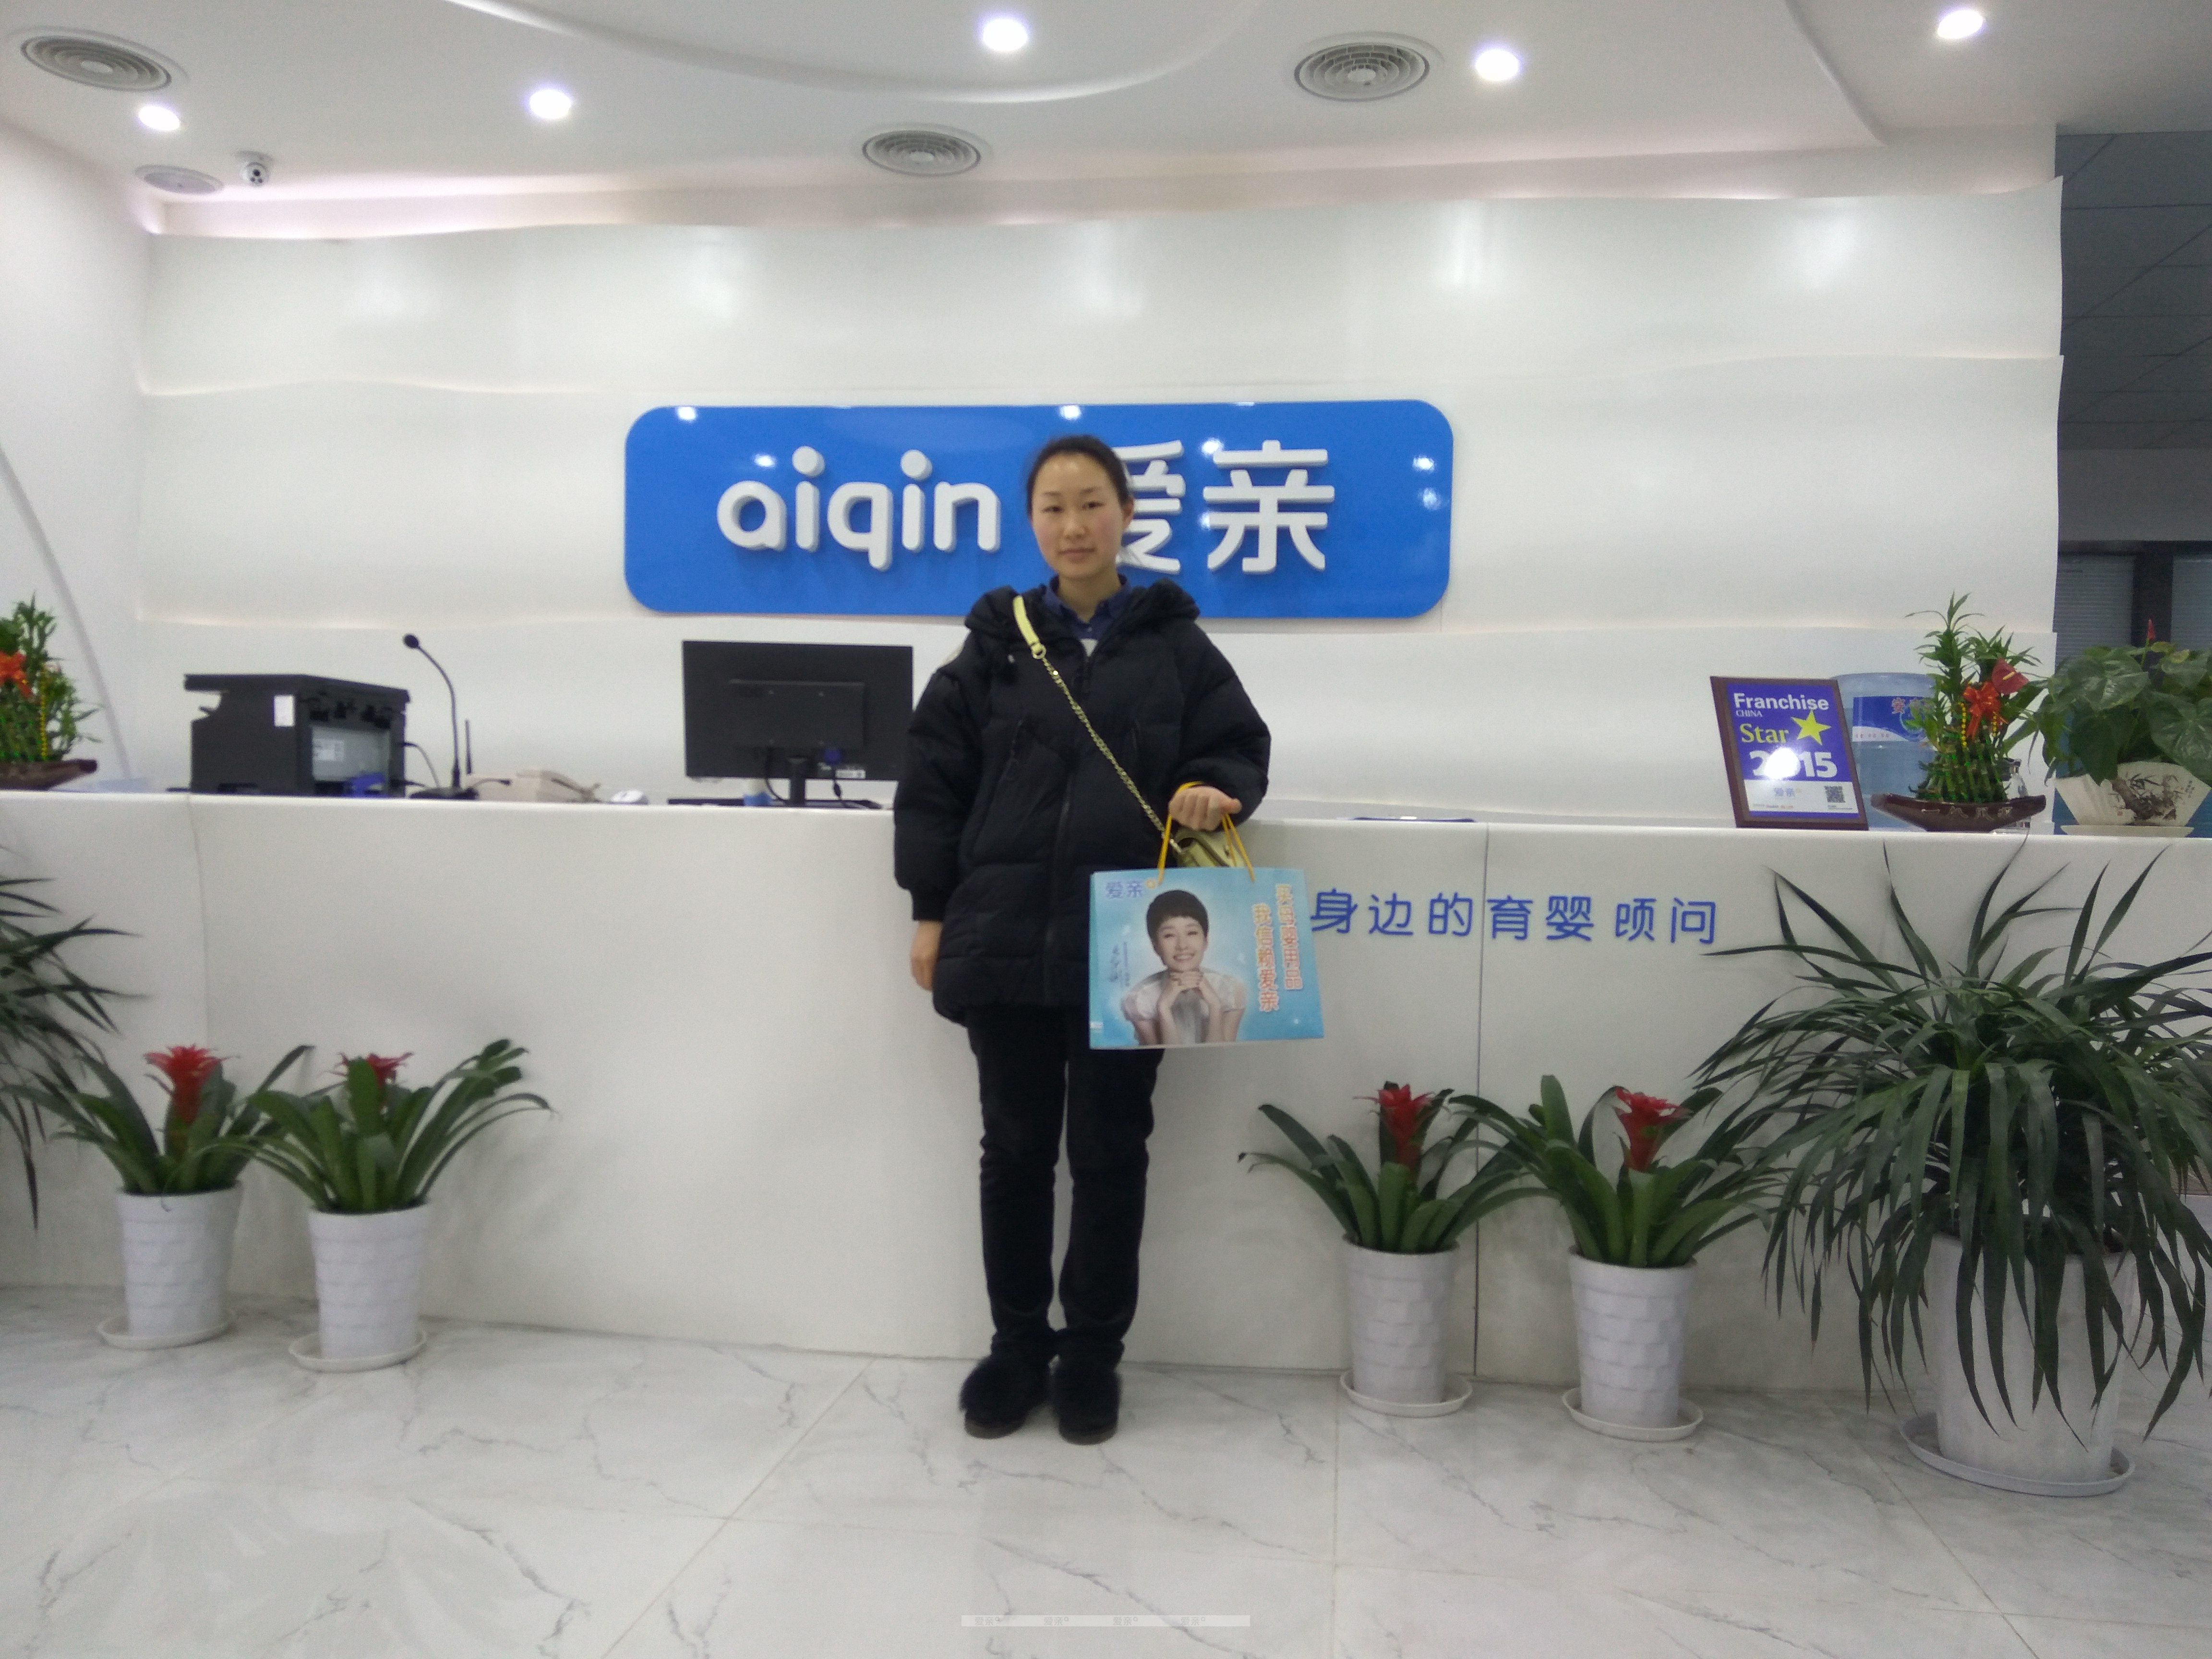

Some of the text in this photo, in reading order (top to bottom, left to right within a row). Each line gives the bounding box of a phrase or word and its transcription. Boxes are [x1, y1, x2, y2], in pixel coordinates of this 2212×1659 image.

[717, 445, 1001, 573] aiqin
[1733, 692, 1829, 711] Franchise
[1735, 709, 1763, 718] CHINA
[1740, 722, 1790, 744] Star
[1749, 750, 1838, 779] 215
[1106, 879, 1144, 899] 爱亲
